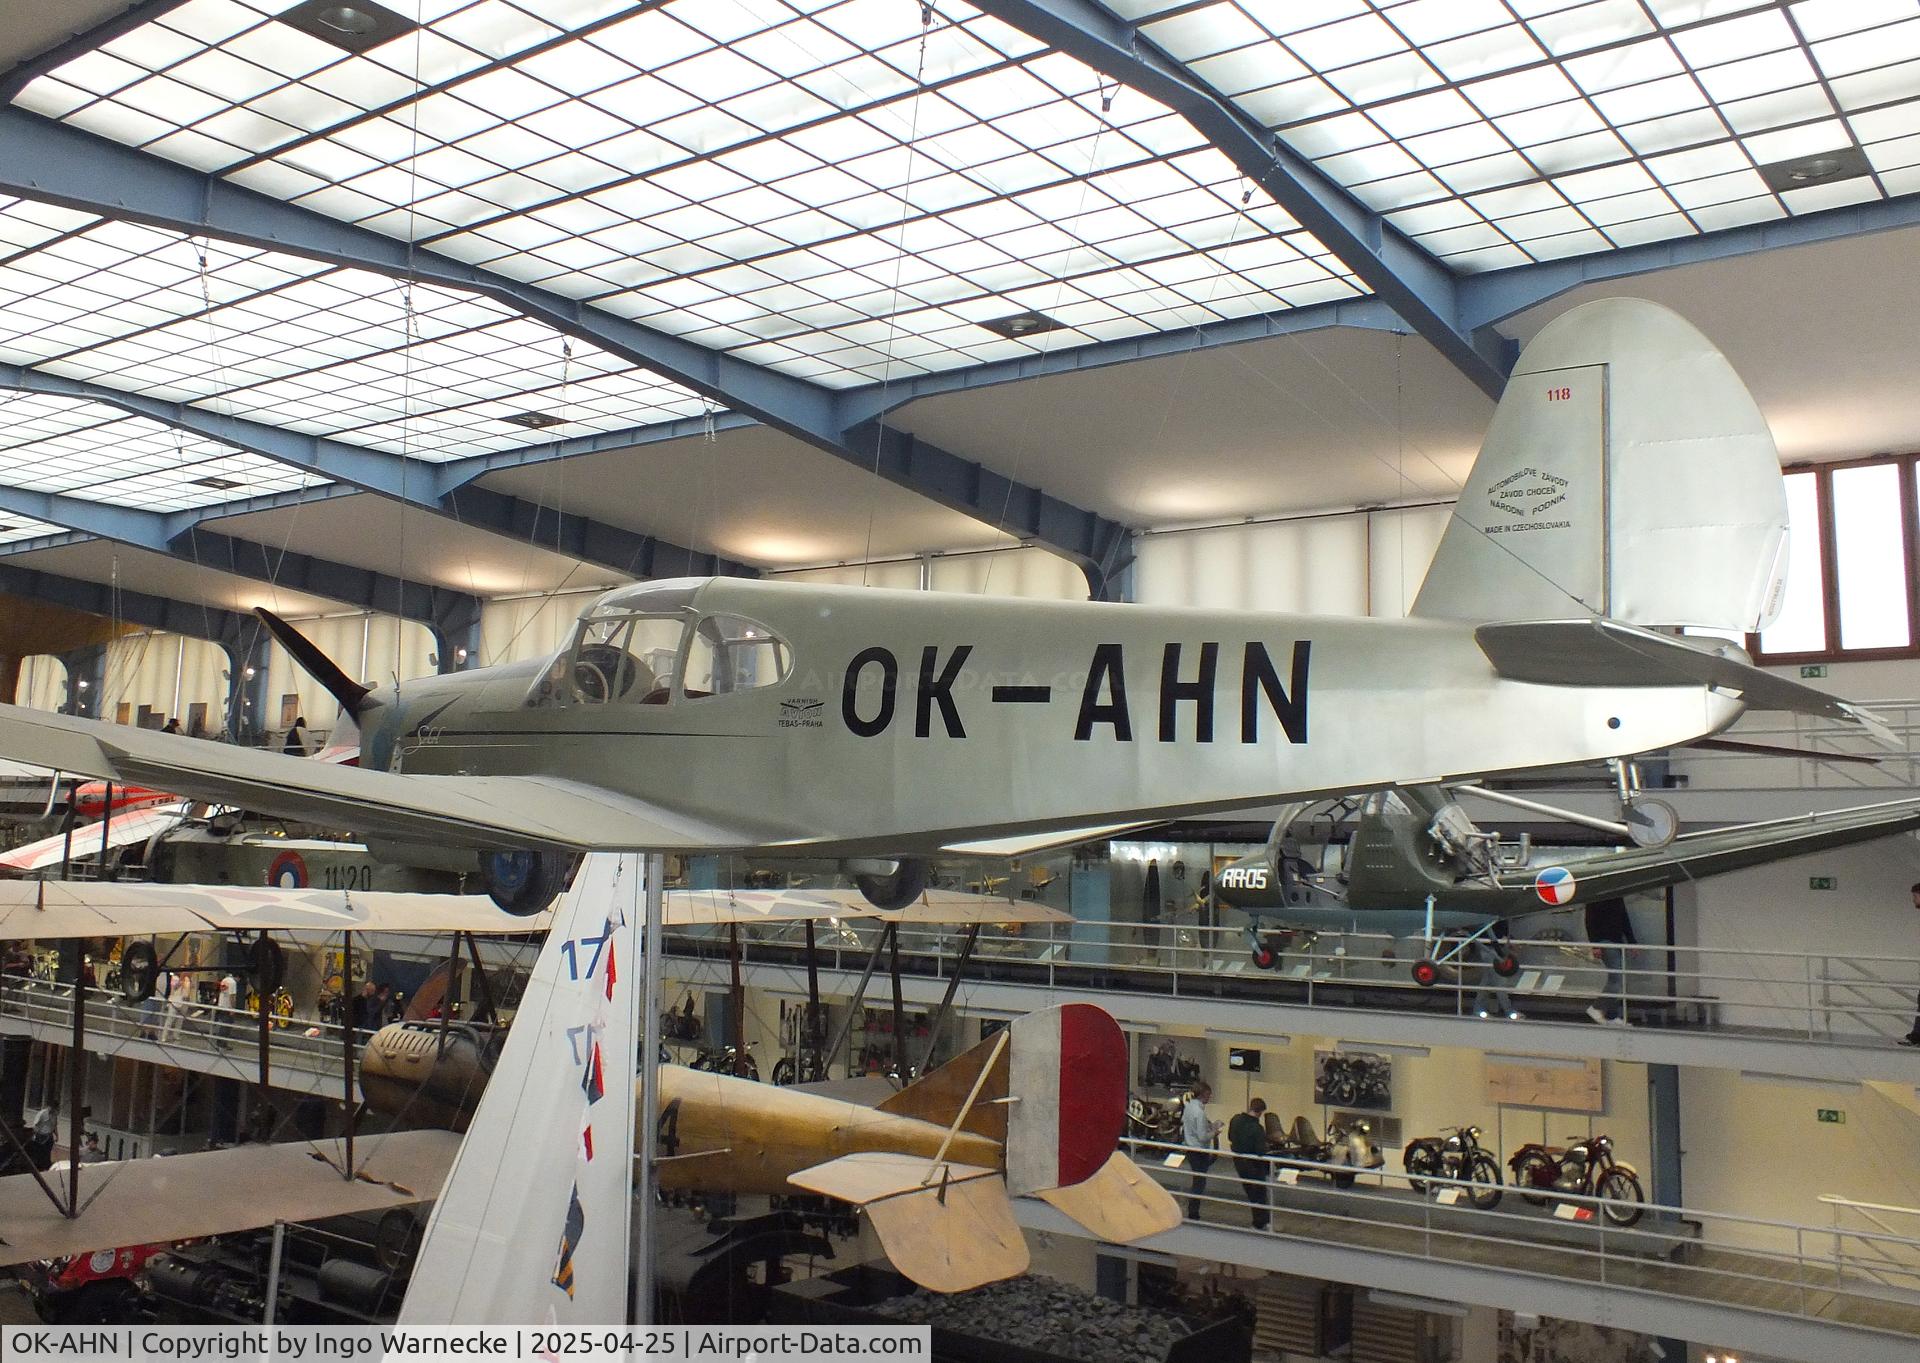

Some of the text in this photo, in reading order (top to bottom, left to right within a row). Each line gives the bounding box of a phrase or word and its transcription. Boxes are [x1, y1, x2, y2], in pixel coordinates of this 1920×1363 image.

[1547, 388, 1570, 401] 118
[1532, 493, 1566, 515] PODNIK
[1485, 525, 1503, 534] MADE
[1512, 521, 1571, 532] CZECHOSLOVAKIA
[561, 934, 608, 980] 17
